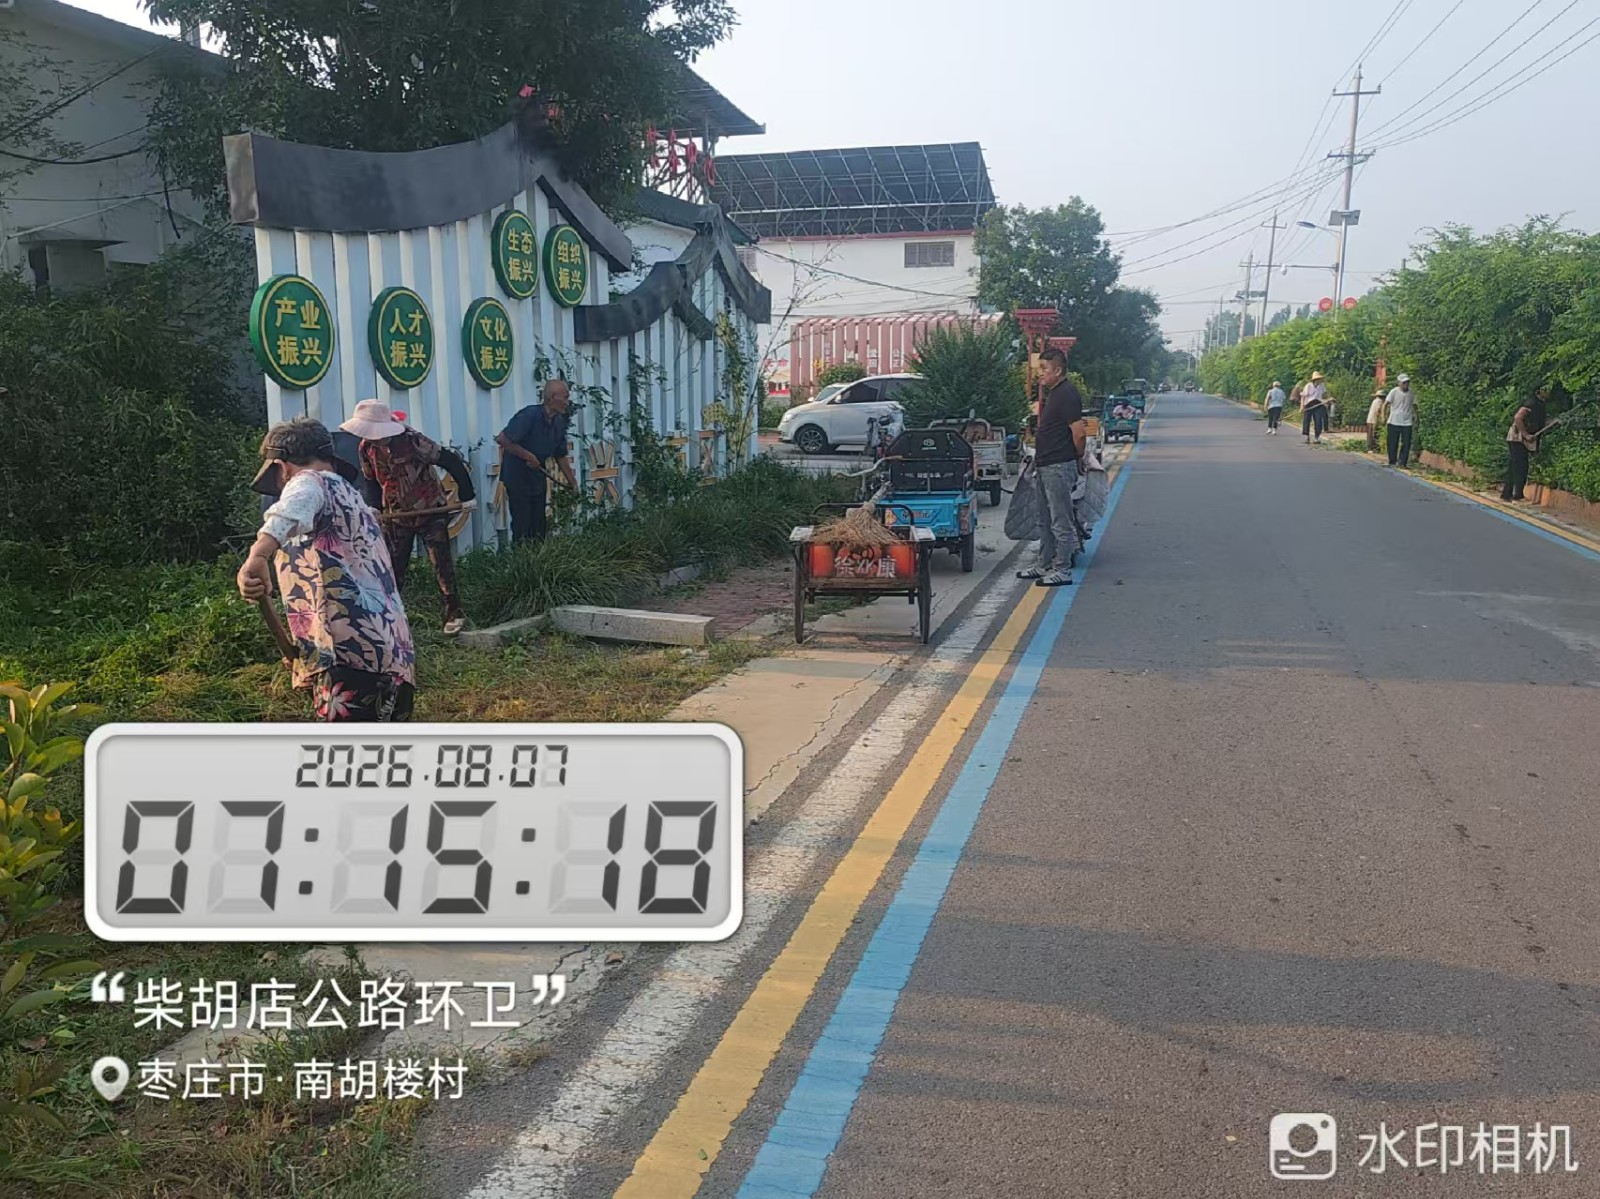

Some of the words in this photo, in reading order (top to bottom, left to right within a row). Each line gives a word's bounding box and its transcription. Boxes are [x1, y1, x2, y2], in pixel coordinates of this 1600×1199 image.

[507, 228, 533, 255] 生态
[557, 240, 582, 264] 组织
[508, 257, 534, 283] 振兴
[558, 268, 582, 291] 振兴
[275, 296, 321, 330] 产业
[389, 308, 424, 336] 人才
[479, 314, 508, 342] 文化
[277, 335, 323, 366] 振兴
[389, 340, 427, 369] 振兴
[480, 345, 508, 370] 振兴
